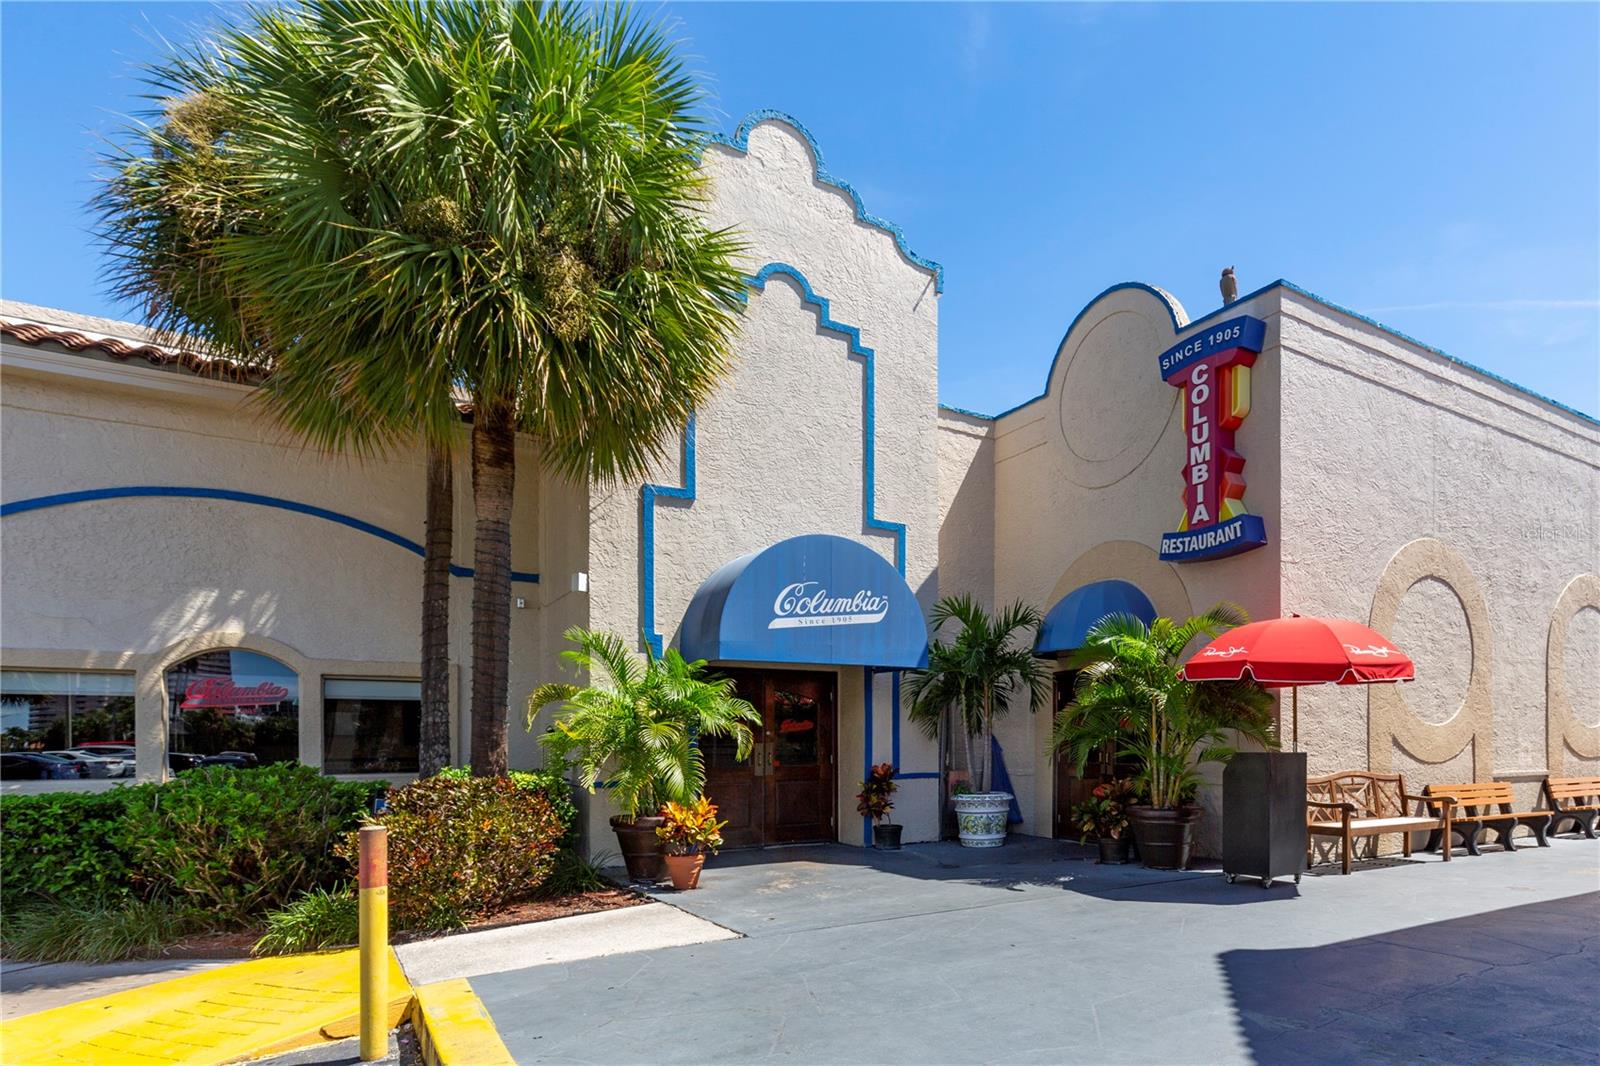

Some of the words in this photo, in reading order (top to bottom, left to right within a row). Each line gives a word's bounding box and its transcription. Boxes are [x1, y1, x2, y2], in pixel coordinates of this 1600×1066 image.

[1162, 340, 1202, 370] SINCE
[1208, 326, 1241, 346] 1905
[1190, 364, 1211, 525] COLUMBIA
[1161, 521, 1242, 554] RESTAURANT
[774, 581, 886, 617] Columbia
[798, 617, 826, 625] Since
[832, 615, 853, 624] 1905
